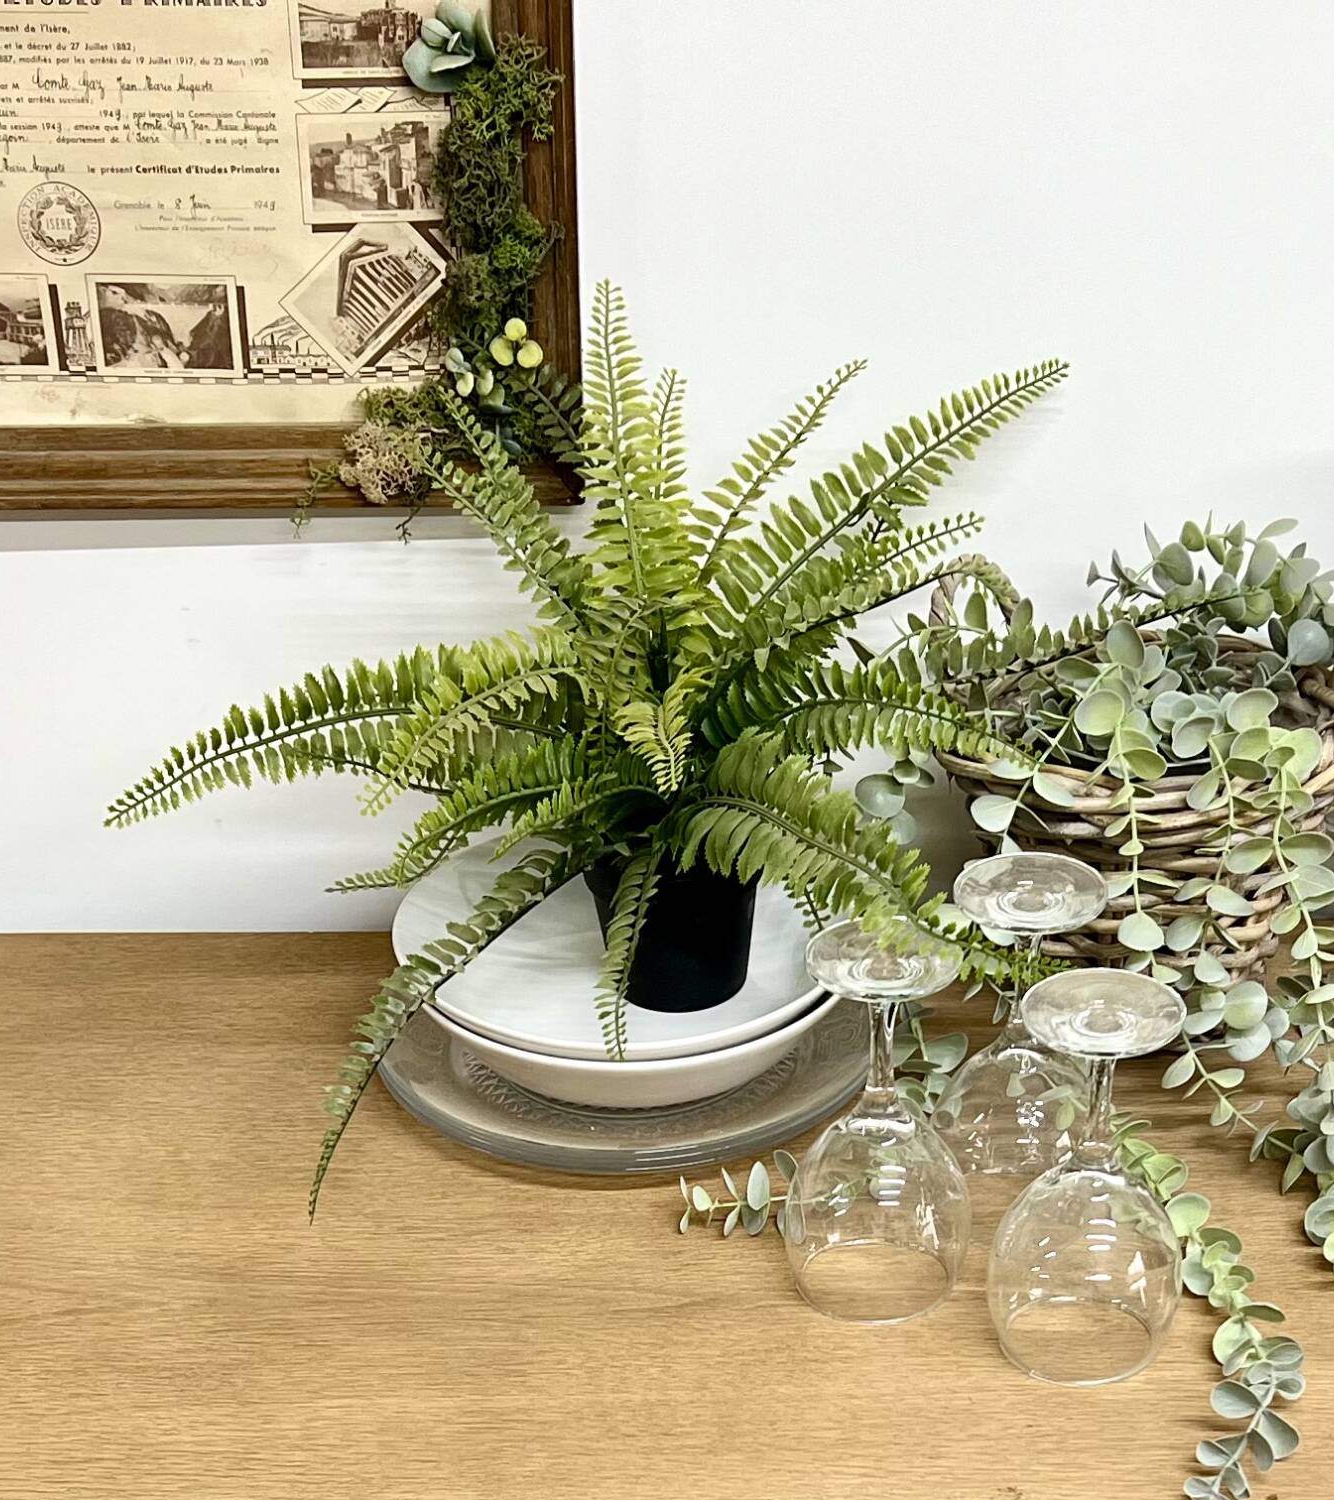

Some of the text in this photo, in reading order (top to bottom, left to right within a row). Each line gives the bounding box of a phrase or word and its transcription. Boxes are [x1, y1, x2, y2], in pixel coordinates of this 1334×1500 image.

[24, 23, 36, 32] de
[135, 164, 182, 174] Certificat
[185, 164, 229, 174] d'Etudes
[230, 165, 280, 174] Primaires
